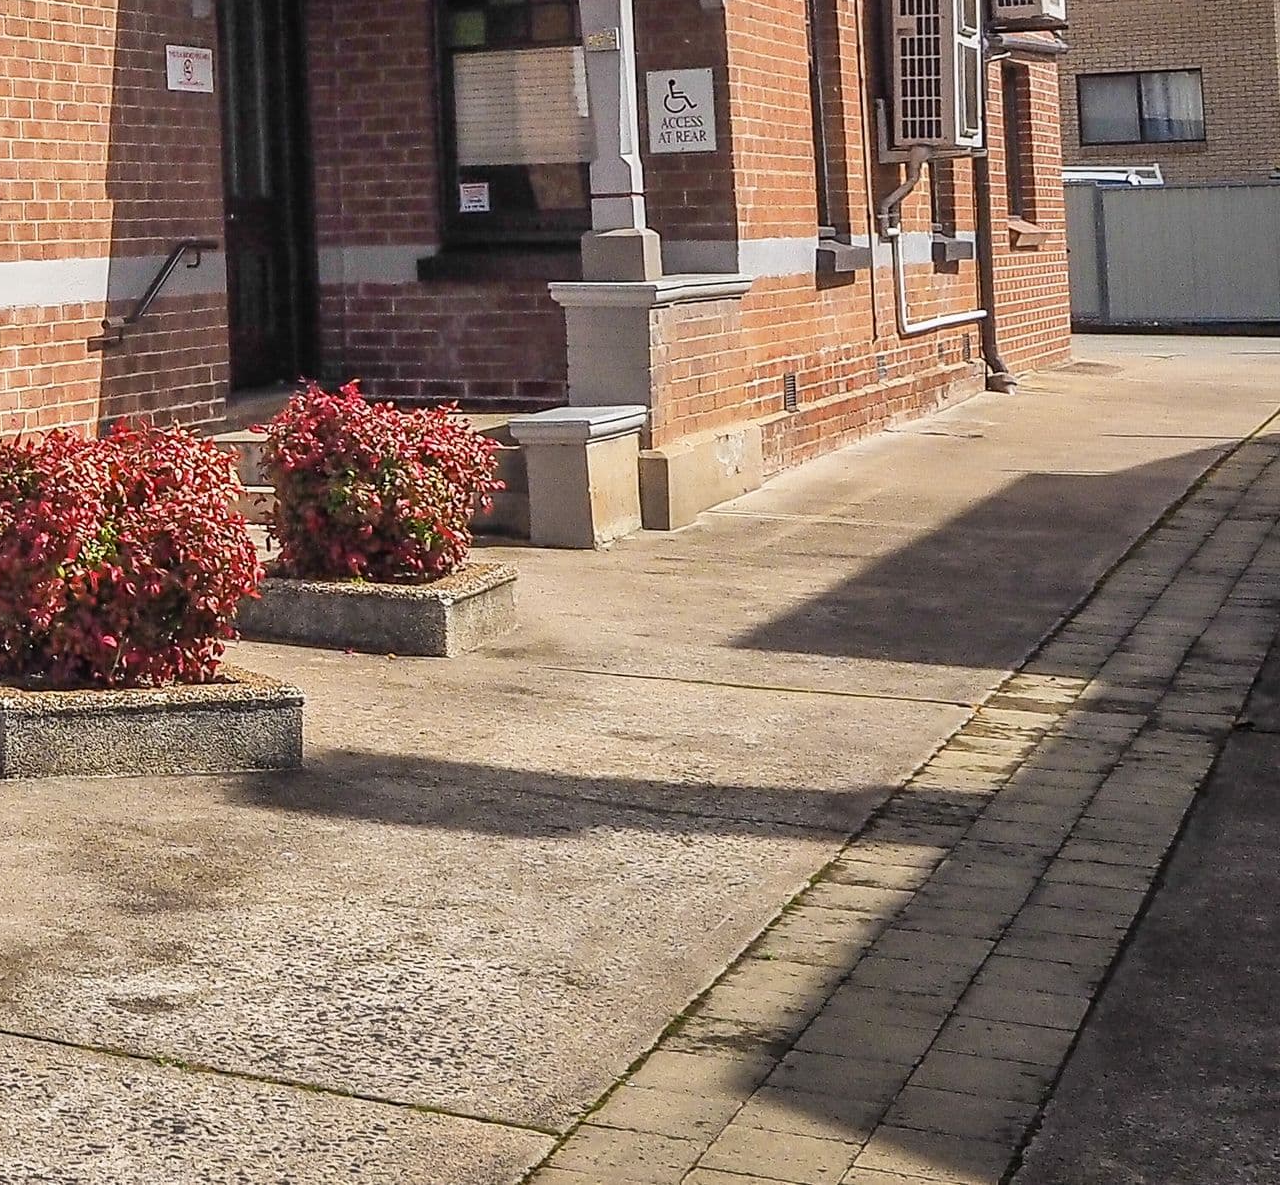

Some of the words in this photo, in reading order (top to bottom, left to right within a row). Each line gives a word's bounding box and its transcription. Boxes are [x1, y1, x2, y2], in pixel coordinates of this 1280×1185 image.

[661, 115, 704, 129] ACCESS
[658, 131, 672, 144] AT
[675, 129, 707, 143] REAR
